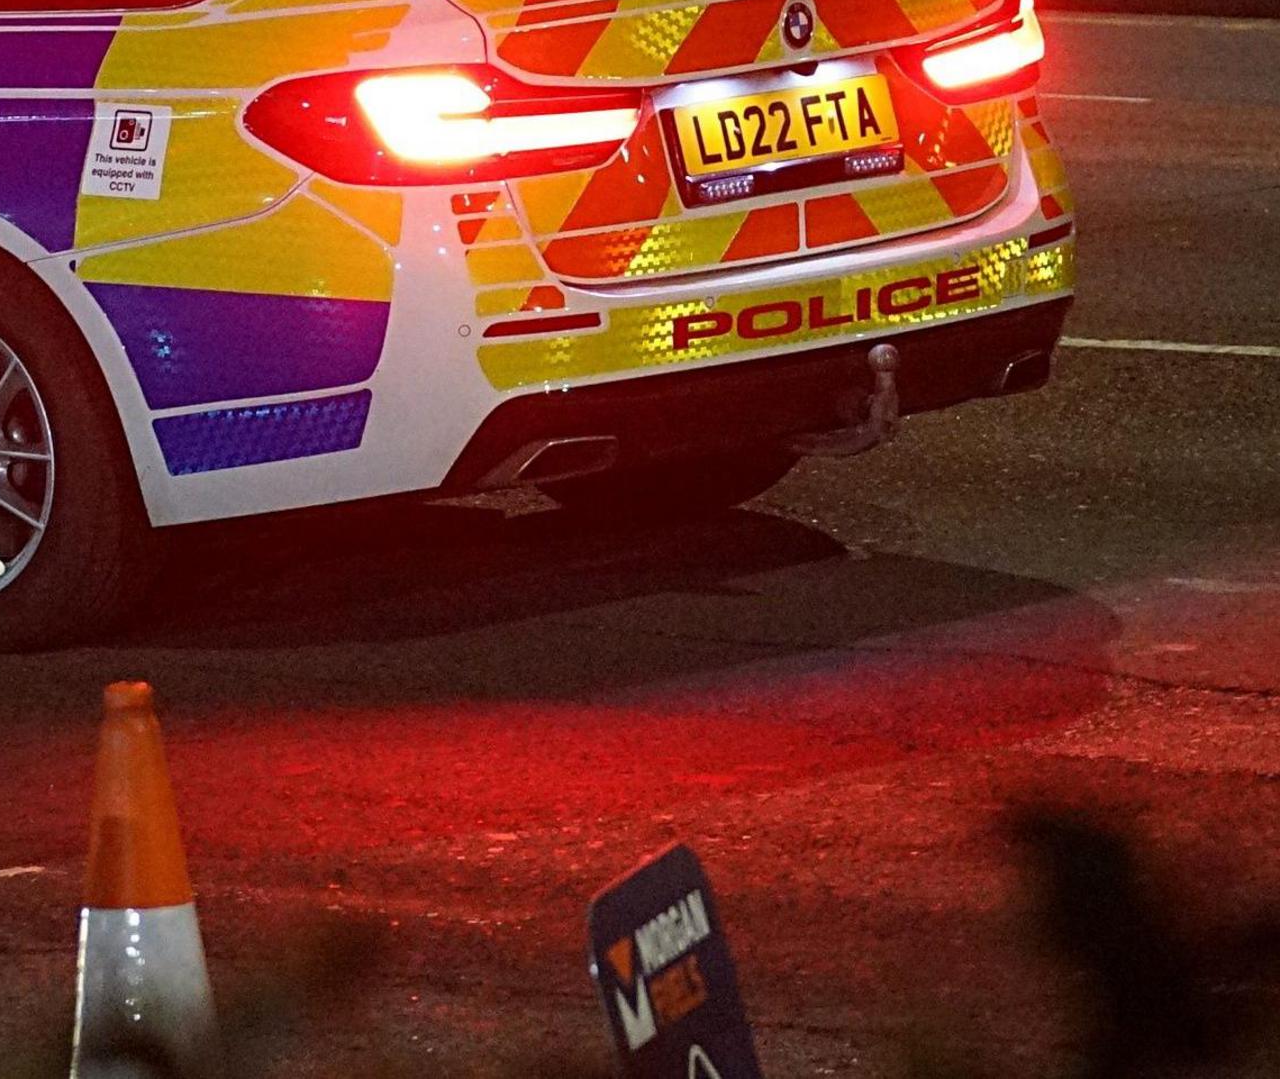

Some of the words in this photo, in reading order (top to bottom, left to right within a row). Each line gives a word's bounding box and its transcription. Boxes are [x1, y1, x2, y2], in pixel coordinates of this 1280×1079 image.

[692, 101, 798, 165] LD22
[800, 86, 882, 147] FTA
[95, 152, 113, 163] This
[115, 155, 147, 166] vehicle
[148, 157, 157, 167] is
[91, 168, 134, 179] equipped
[135, 170, 154, 180] with
[109, 181, 135, 193] CCTV
[672, 265, 981, 350] POLICE
